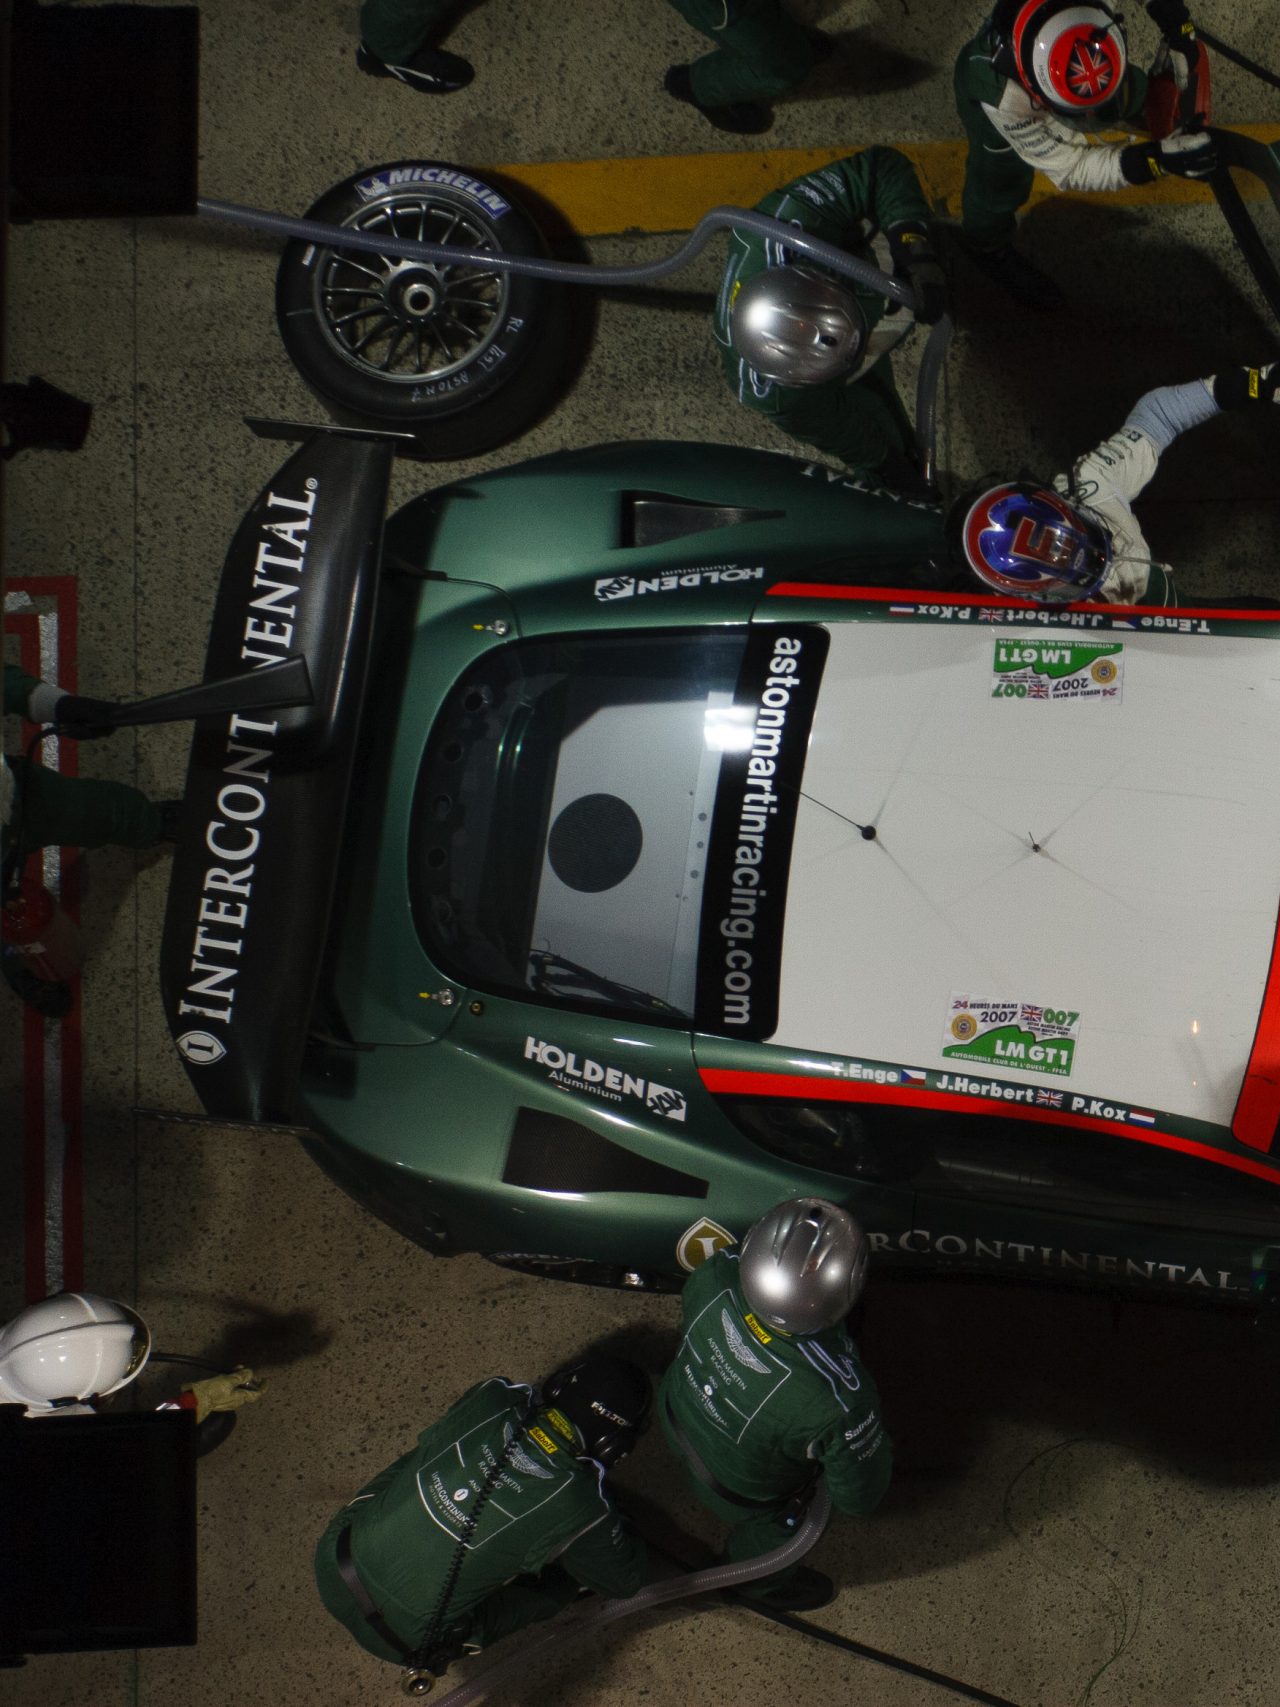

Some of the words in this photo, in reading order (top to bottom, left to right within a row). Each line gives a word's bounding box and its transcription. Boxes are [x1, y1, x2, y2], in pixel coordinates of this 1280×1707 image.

[388, 167, 507, 213] MICHELIN
[637, 567, 764, 595] HOLDEN
[915, 604, 971, 620] P.Kox
[1005, 607, 1103, 627] J.Herbert
[1141, 616, 1211, 634] T.Enge
[992, 683, 1028, 698] 007
[1053, 678, 1089, 692] 2007
[178, 480, 318, 1024] INTERCONTNENTAL
[720, 635, 802, 1026] astonmartinracing.com
[952, 1000, 968, 1009] 24
[980, 1011, 1018, 1023] 2007
[1043, 1008, 1080, 1027] 007
[523, 1035, 646, 1099] HOLDEN
[950, 1051, 991, 1063] AUTOMOBILE
[992, 1056, 1009, 1064] CLUB
[548, 1070, 623, 1102] Aluminium
[935, 1074, 1034, 1103] J.Herbert
[1070, 1095, 1127, 1122] P.Kox
[866, 1229, 1239, 1291] RCONTINENTAL
[707, 1337, 726, 1362] ASTON
[724, 1361, 748, 1391] MARTIN
[710, 1356, 732, 1387] RACING
[531, 1427, 556, 1452] Sabelt
[468, 1479, 482, 1493] AND
